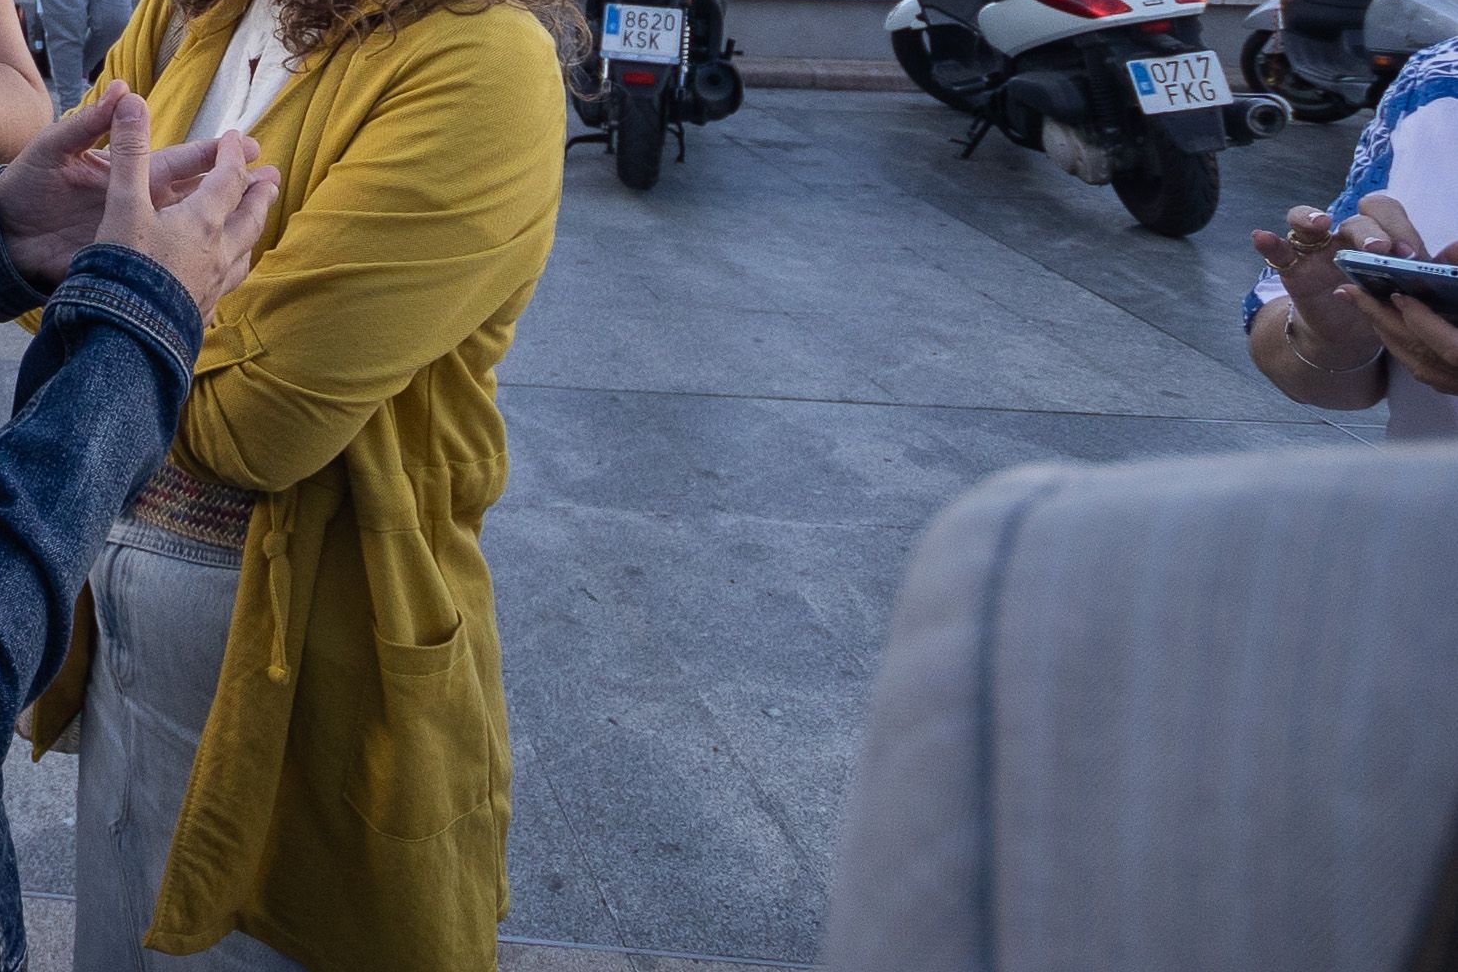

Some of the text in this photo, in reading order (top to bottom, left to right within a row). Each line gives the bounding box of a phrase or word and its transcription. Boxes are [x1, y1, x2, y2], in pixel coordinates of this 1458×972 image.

[625, 11, 676, 32] 8620
[622, 29, 661, 50] KSK
[1150, 56, 1210, 84] 0717
[1164, 80, 1216, 106] FKG
